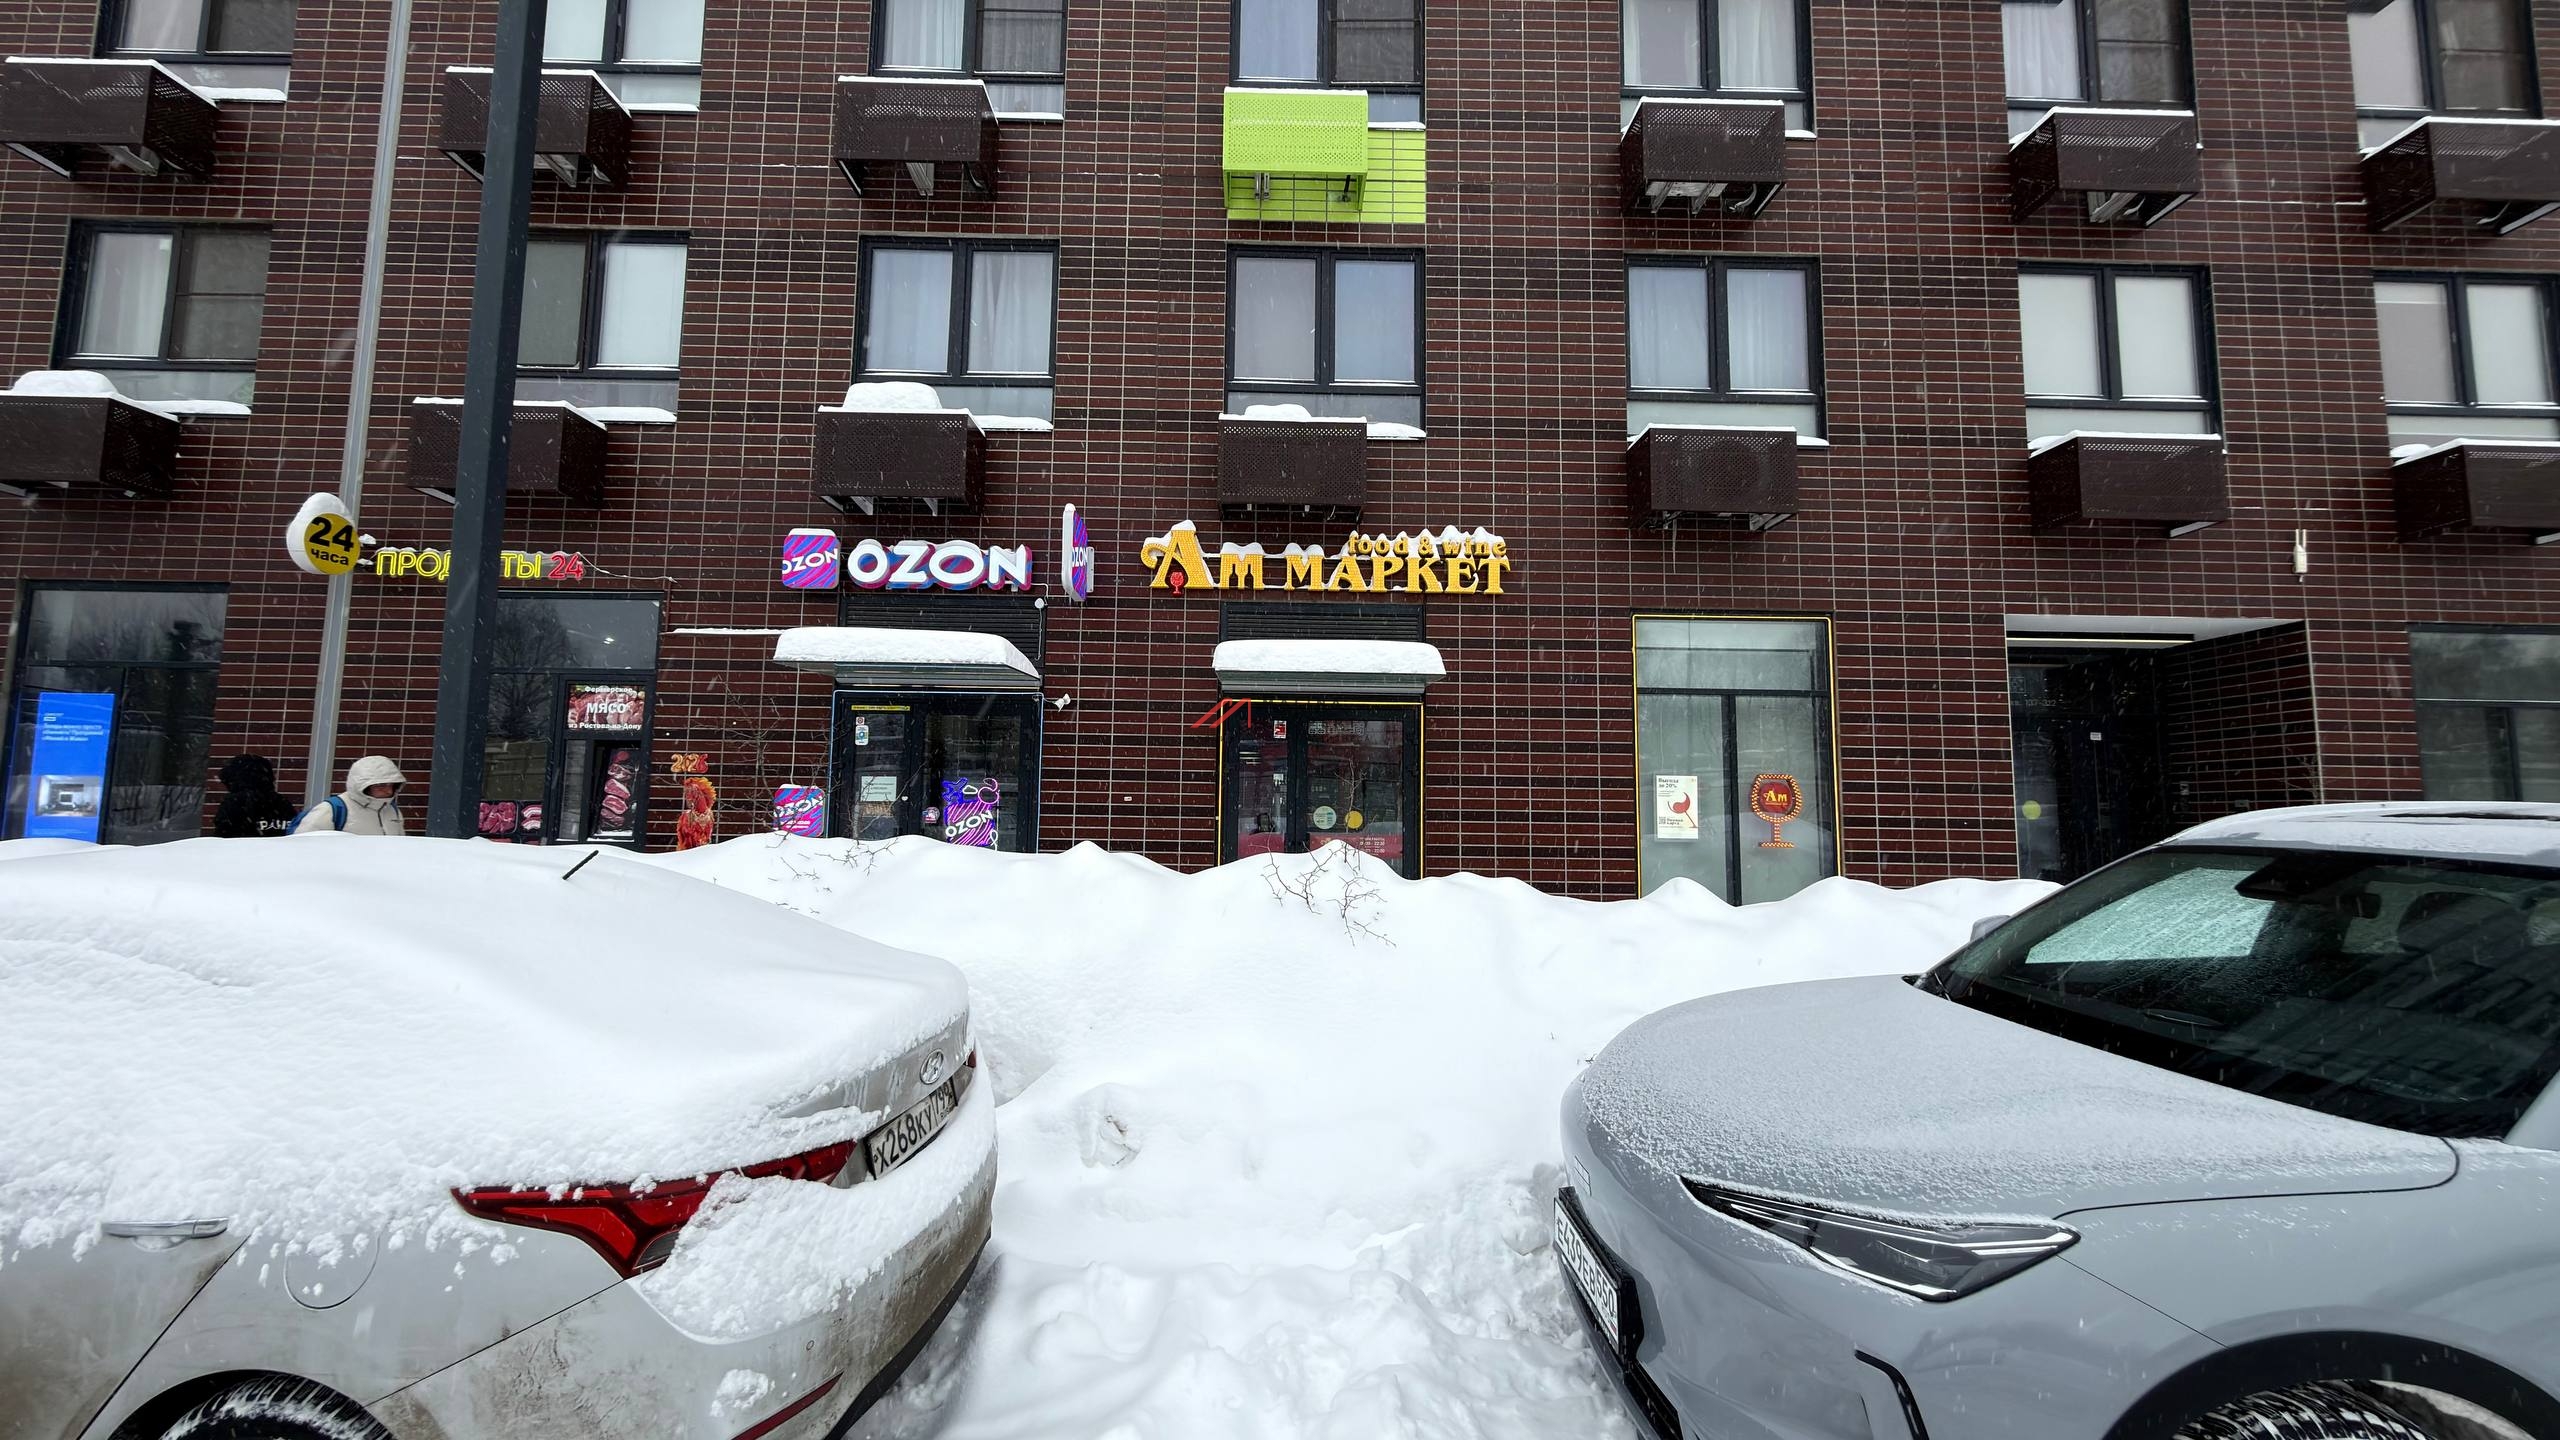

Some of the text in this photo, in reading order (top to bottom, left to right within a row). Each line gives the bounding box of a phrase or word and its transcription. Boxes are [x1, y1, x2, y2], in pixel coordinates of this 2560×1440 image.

[309, 516, 355, 552] 24
[1348, 534, 1507, 556] food & wine
[311, 548, 350, 566] часа
[548, 554, 584, 580] 24
[782, 548, 839, 575] OZON
[848, 544, 1028, 585] OZON
[1285, 553, 1511, 595] МАРКЕТ
[586, 702, 626, 714] МЯСО
[580, 722, 642, 730] Ростова-на-Дону
[773, 795, 824, 818] OZON
[945, 810, 994, 838] OZON
